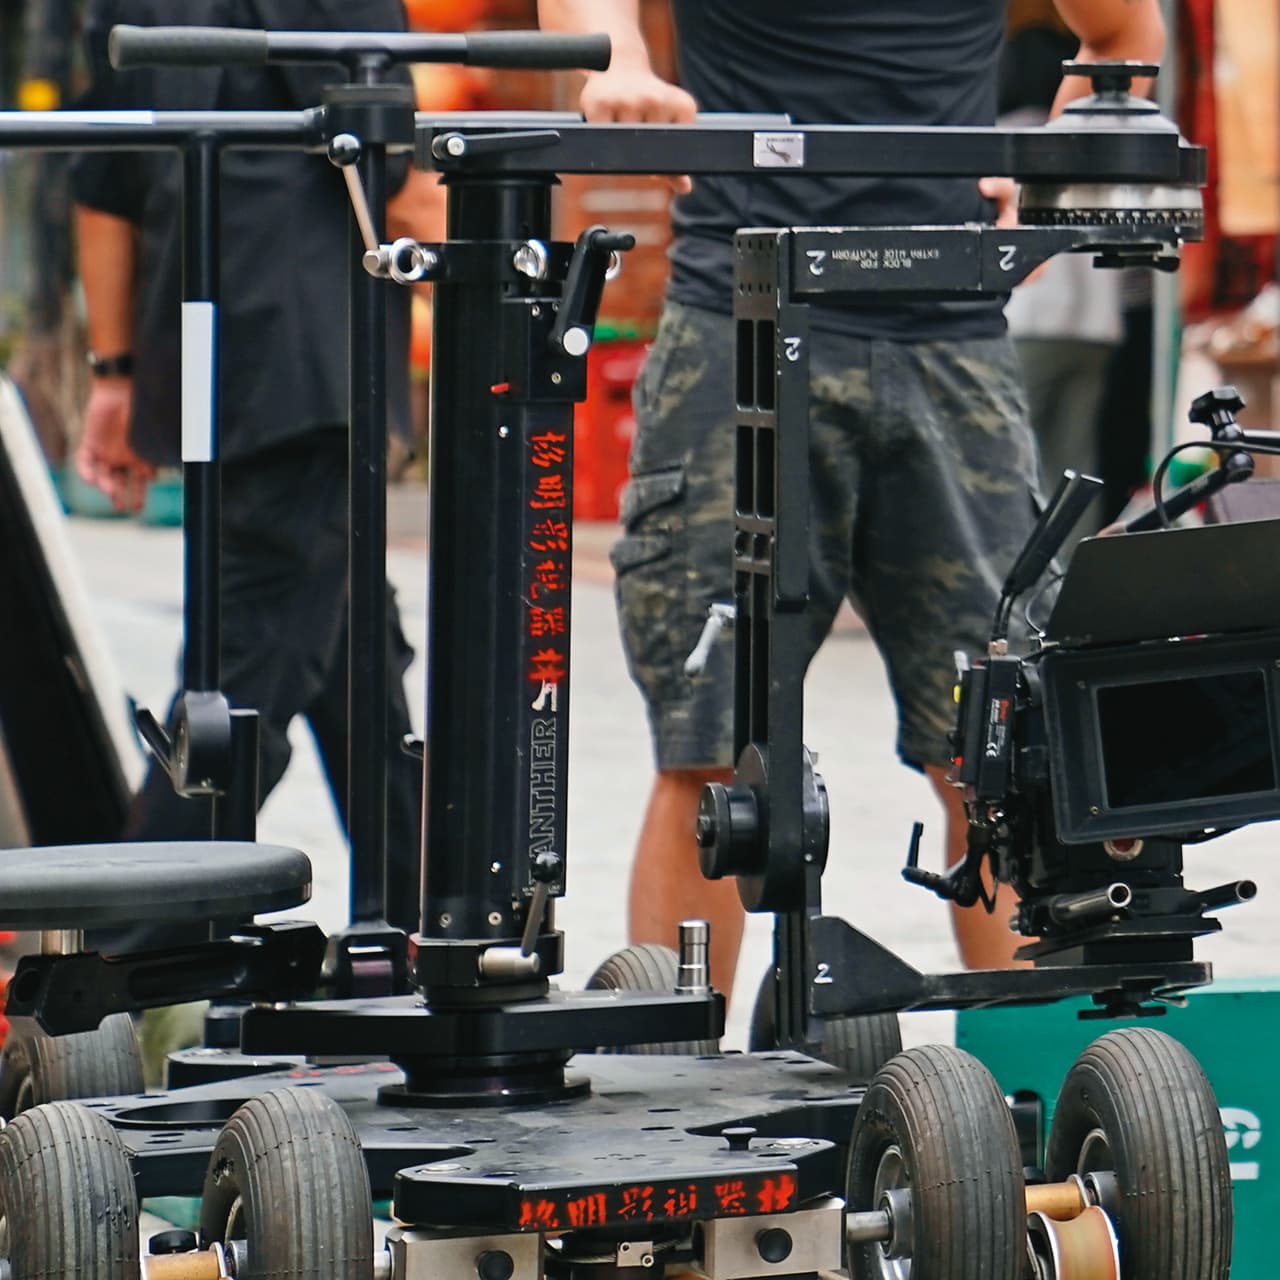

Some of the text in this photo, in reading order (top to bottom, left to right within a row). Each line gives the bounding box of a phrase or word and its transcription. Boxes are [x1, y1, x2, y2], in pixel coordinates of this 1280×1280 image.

[806, 249, 827, 276] 2
[860, 258, 878, 269] FOR
[999, 245, 1017, 271] 2
[784, 336, 802, 362] 2
[529, 717, 557, 886] ANTHER
[813, 963, 833, 984] 2
